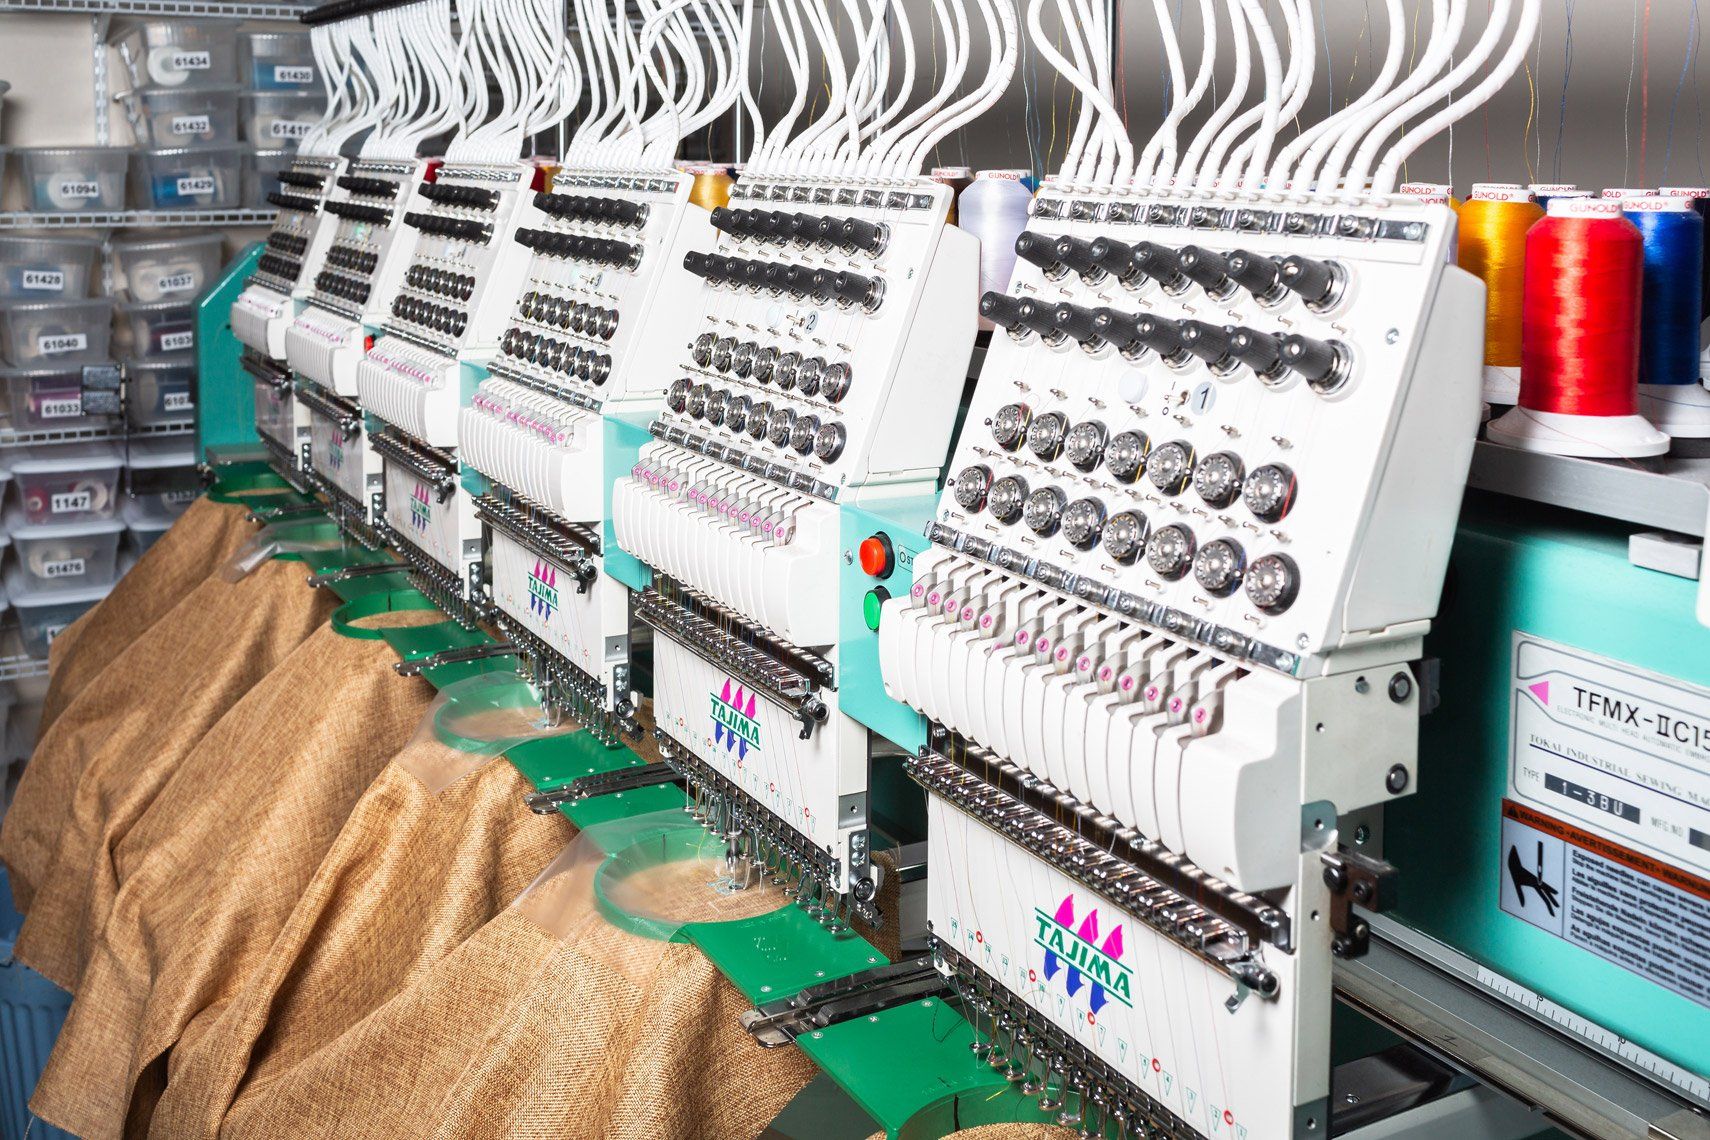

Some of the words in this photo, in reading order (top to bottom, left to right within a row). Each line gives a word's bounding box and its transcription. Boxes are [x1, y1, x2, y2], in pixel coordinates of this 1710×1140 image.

[175, 56, 208, 66] 61434
[62, 184, 96, 194] 61094
[44, 339, 78, 350] 61040
[1200, 387, 1209, 409] 1
[54, 497, 88, 509] 1147
[528, 576, 558, 607] TAJIMA
[711, 698, 760, 746] TAJIMA
[1567, 746, 1630, 778] INDUSTRIAL
[1036, 916, 1132, 1000] TAJIMA
